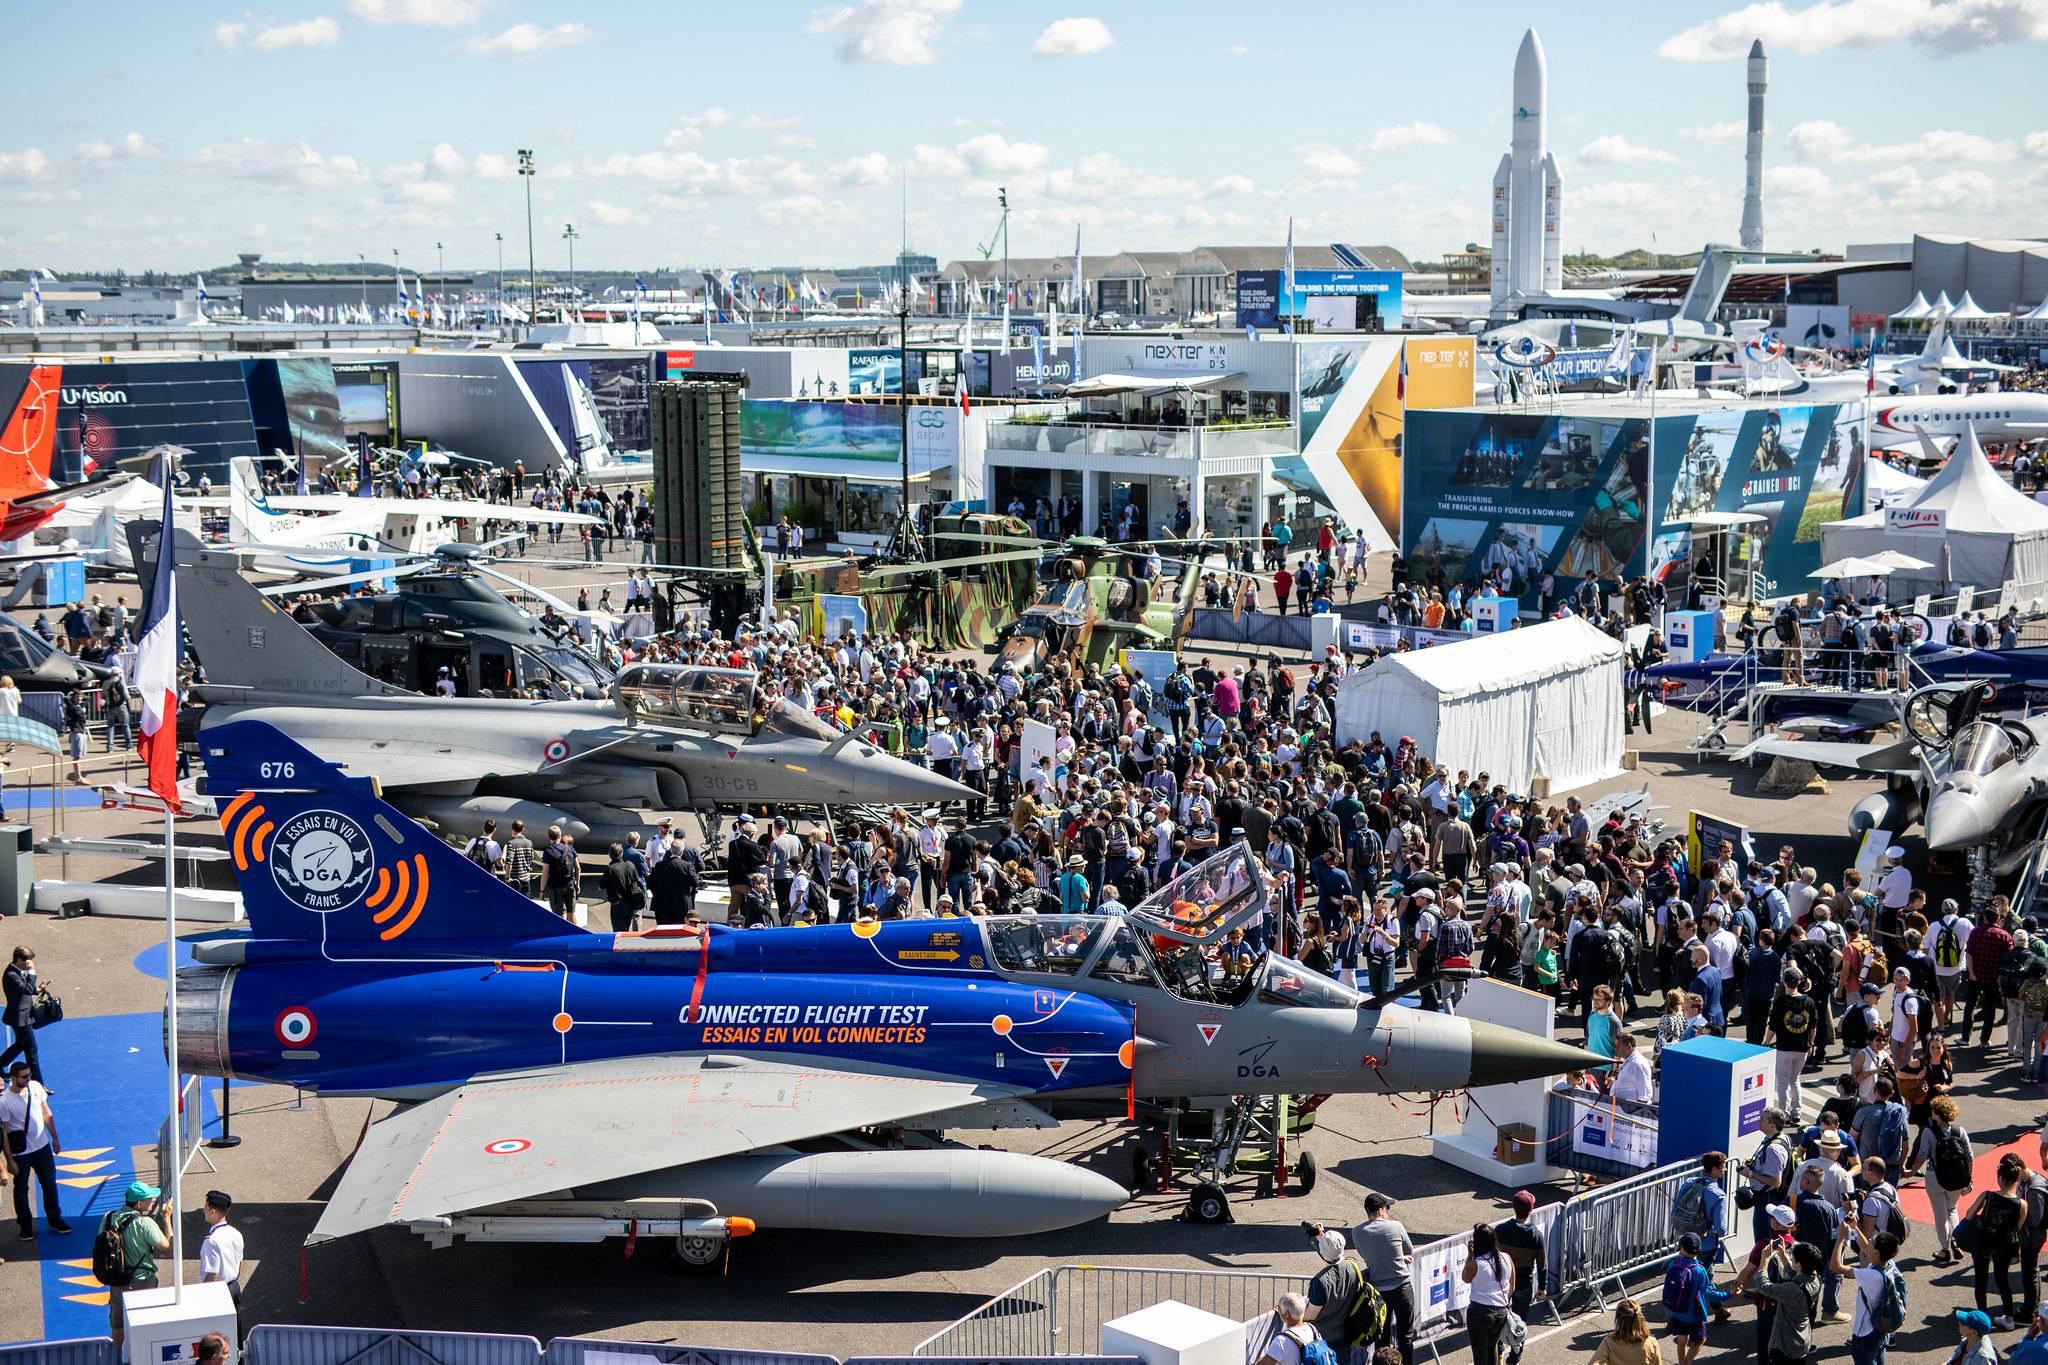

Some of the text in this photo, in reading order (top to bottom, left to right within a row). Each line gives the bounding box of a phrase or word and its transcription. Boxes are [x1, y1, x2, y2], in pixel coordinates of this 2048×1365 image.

[1444, 494, 1493, 504] TRANSFERRING
[1438, 502, 1575, 518] THE FRENCH ARMED FORCES KNOW-HOW
[260, 761, 296, 779] 676
[286, 816, 359, 844] ESSAIS EN VOL
[303, 868, 342, 881] DGA
[303, 892, 342, 908] FRANCE
[803, 1005, 875, 1024] FLIGHT
[878, 1005, 929, 1024] TEST
[702, 1023, 927, 1043] ESSAIS EN VOL CONNECTÉS
[1237, 1065, 1280, 1078] DGA
